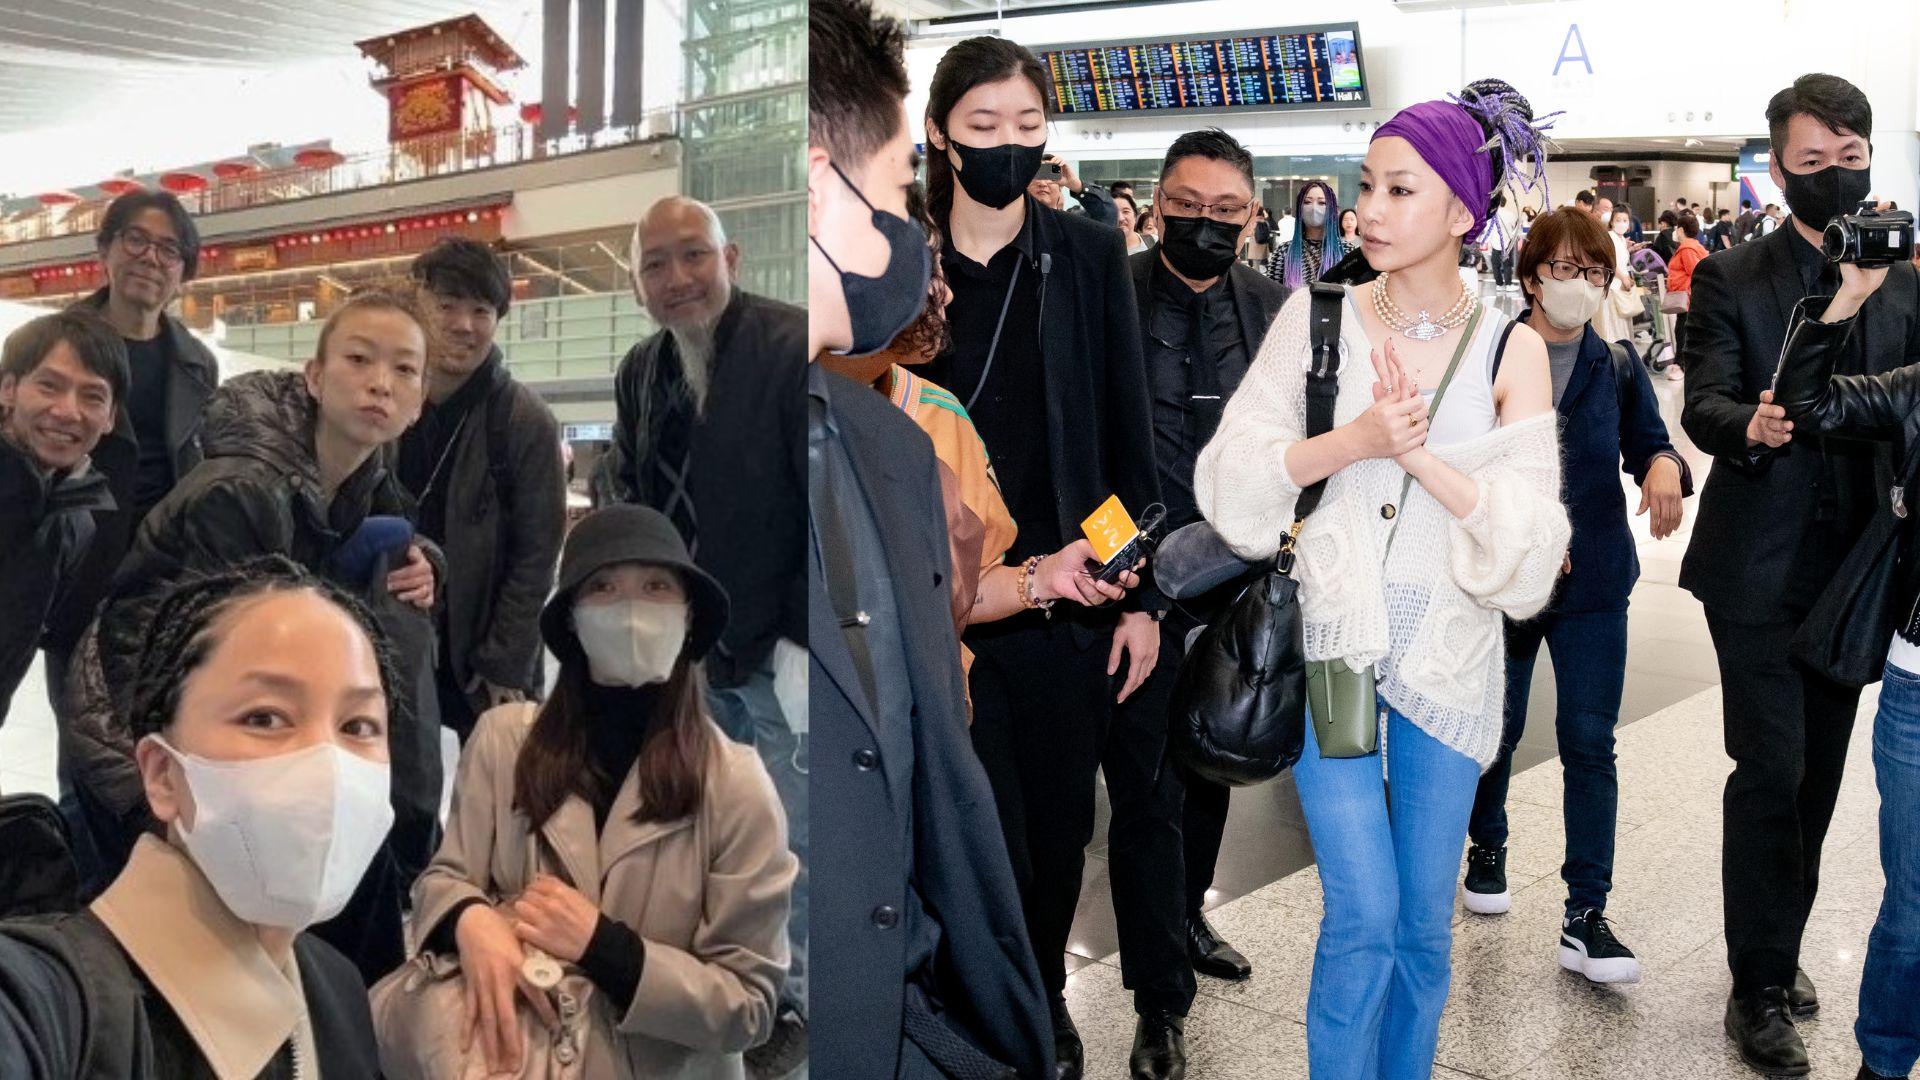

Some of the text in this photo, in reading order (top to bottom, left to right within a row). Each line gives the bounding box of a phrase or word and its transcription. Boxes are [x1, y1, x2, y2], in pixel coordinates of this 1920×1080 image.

[1552, 24, 1594, 76] A
[1337, 91, 1362, 101] Hall A
